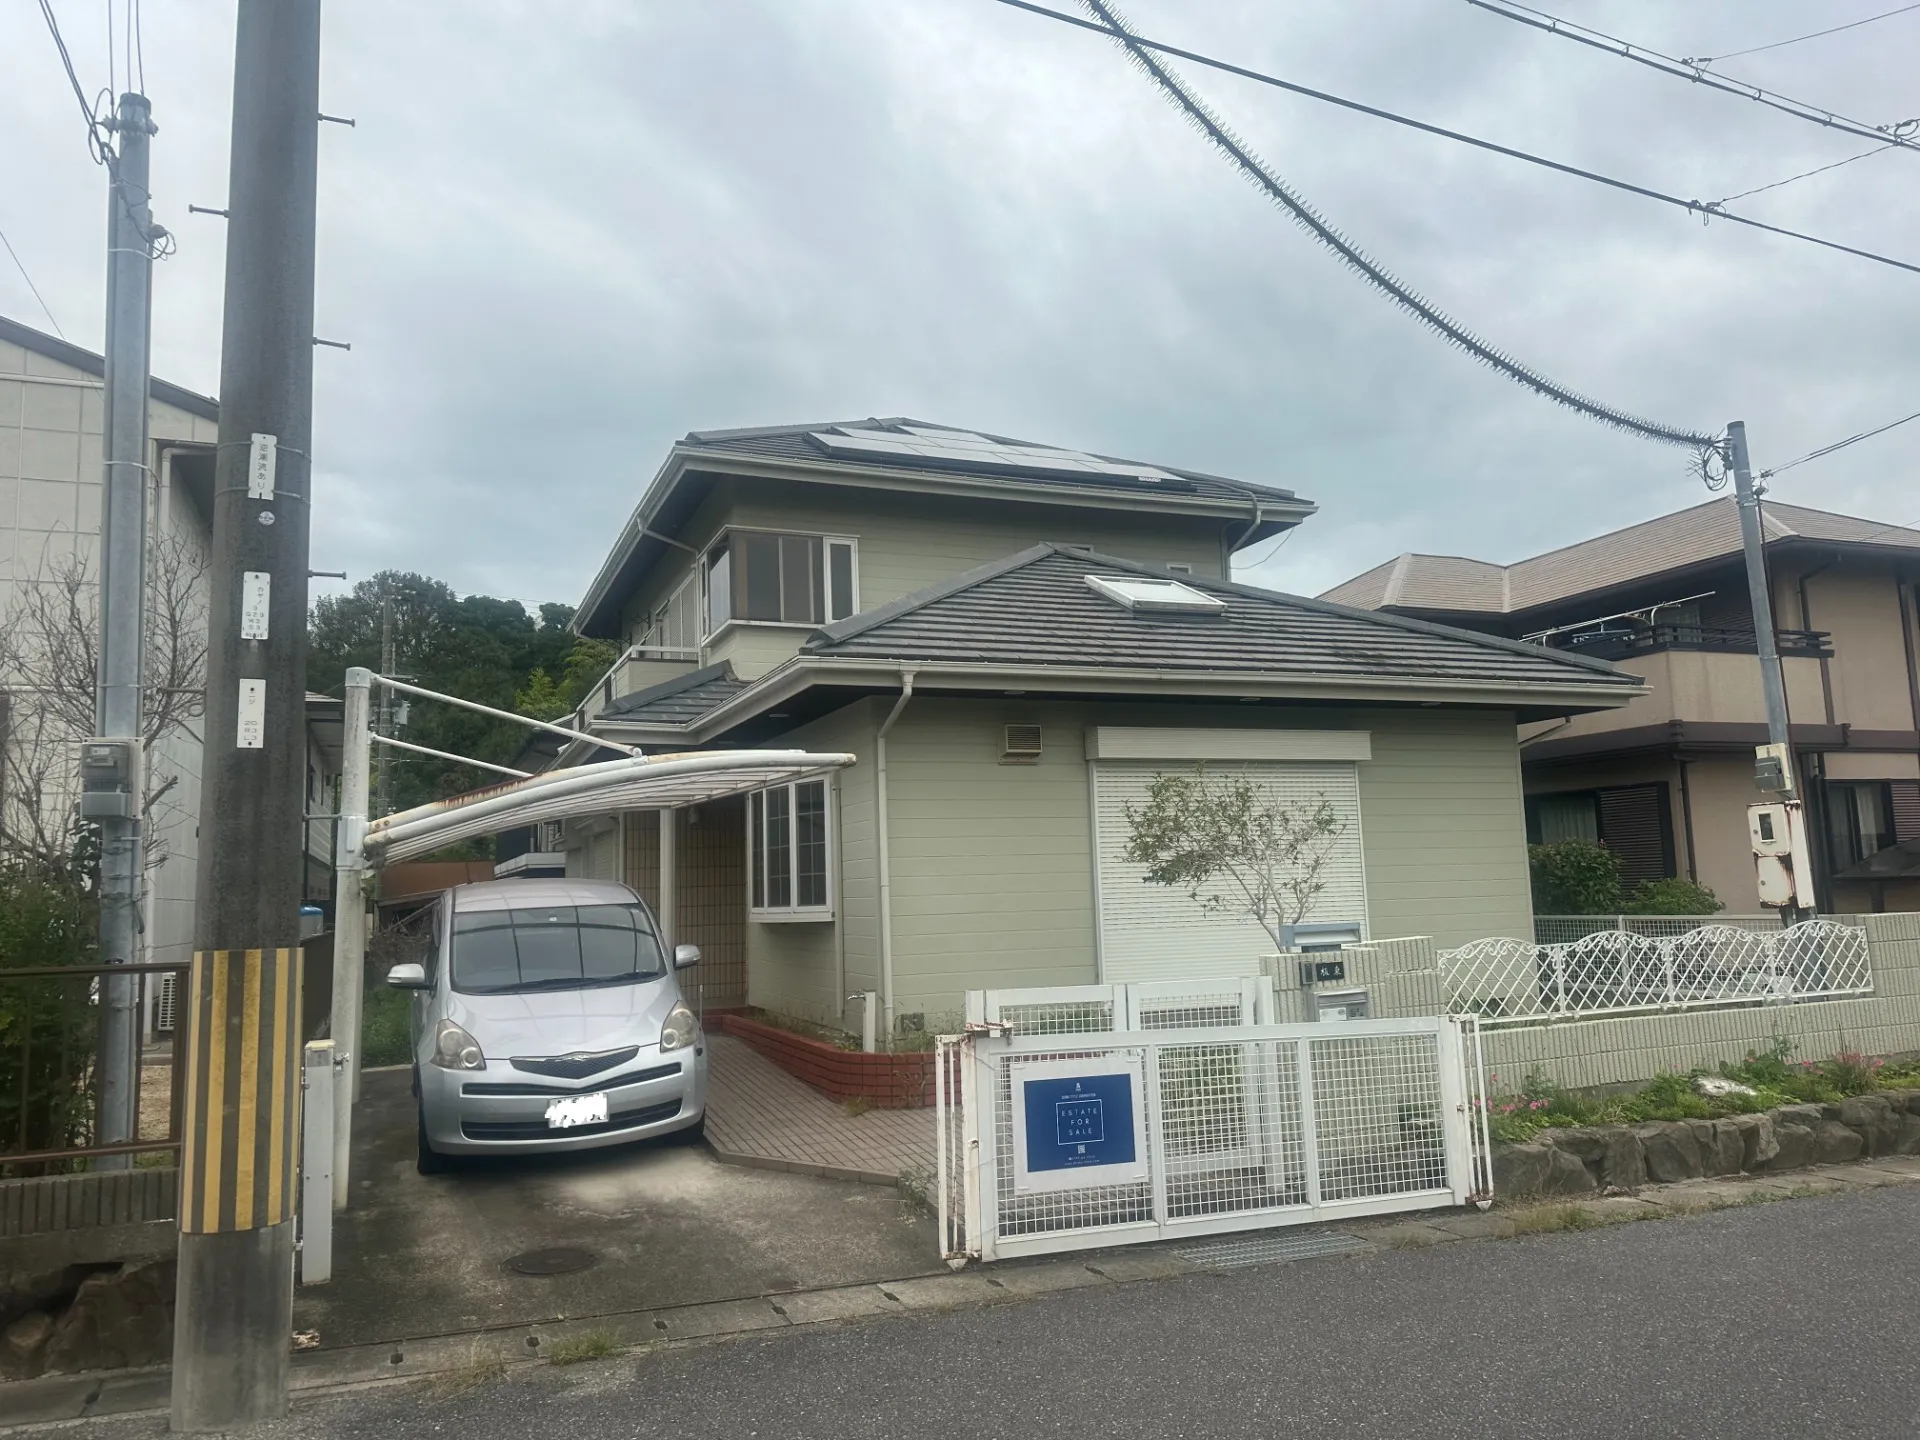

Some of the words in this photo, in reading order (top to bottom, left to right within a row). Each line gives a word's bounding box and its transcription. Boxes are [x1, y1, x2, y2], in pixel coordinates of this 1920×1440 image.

[1061, 1107, 1098, 1117] ESTATE
[1070, 1118, 1090, 1126] FOR
[1068, 1127, 1093, 1136] SALE
